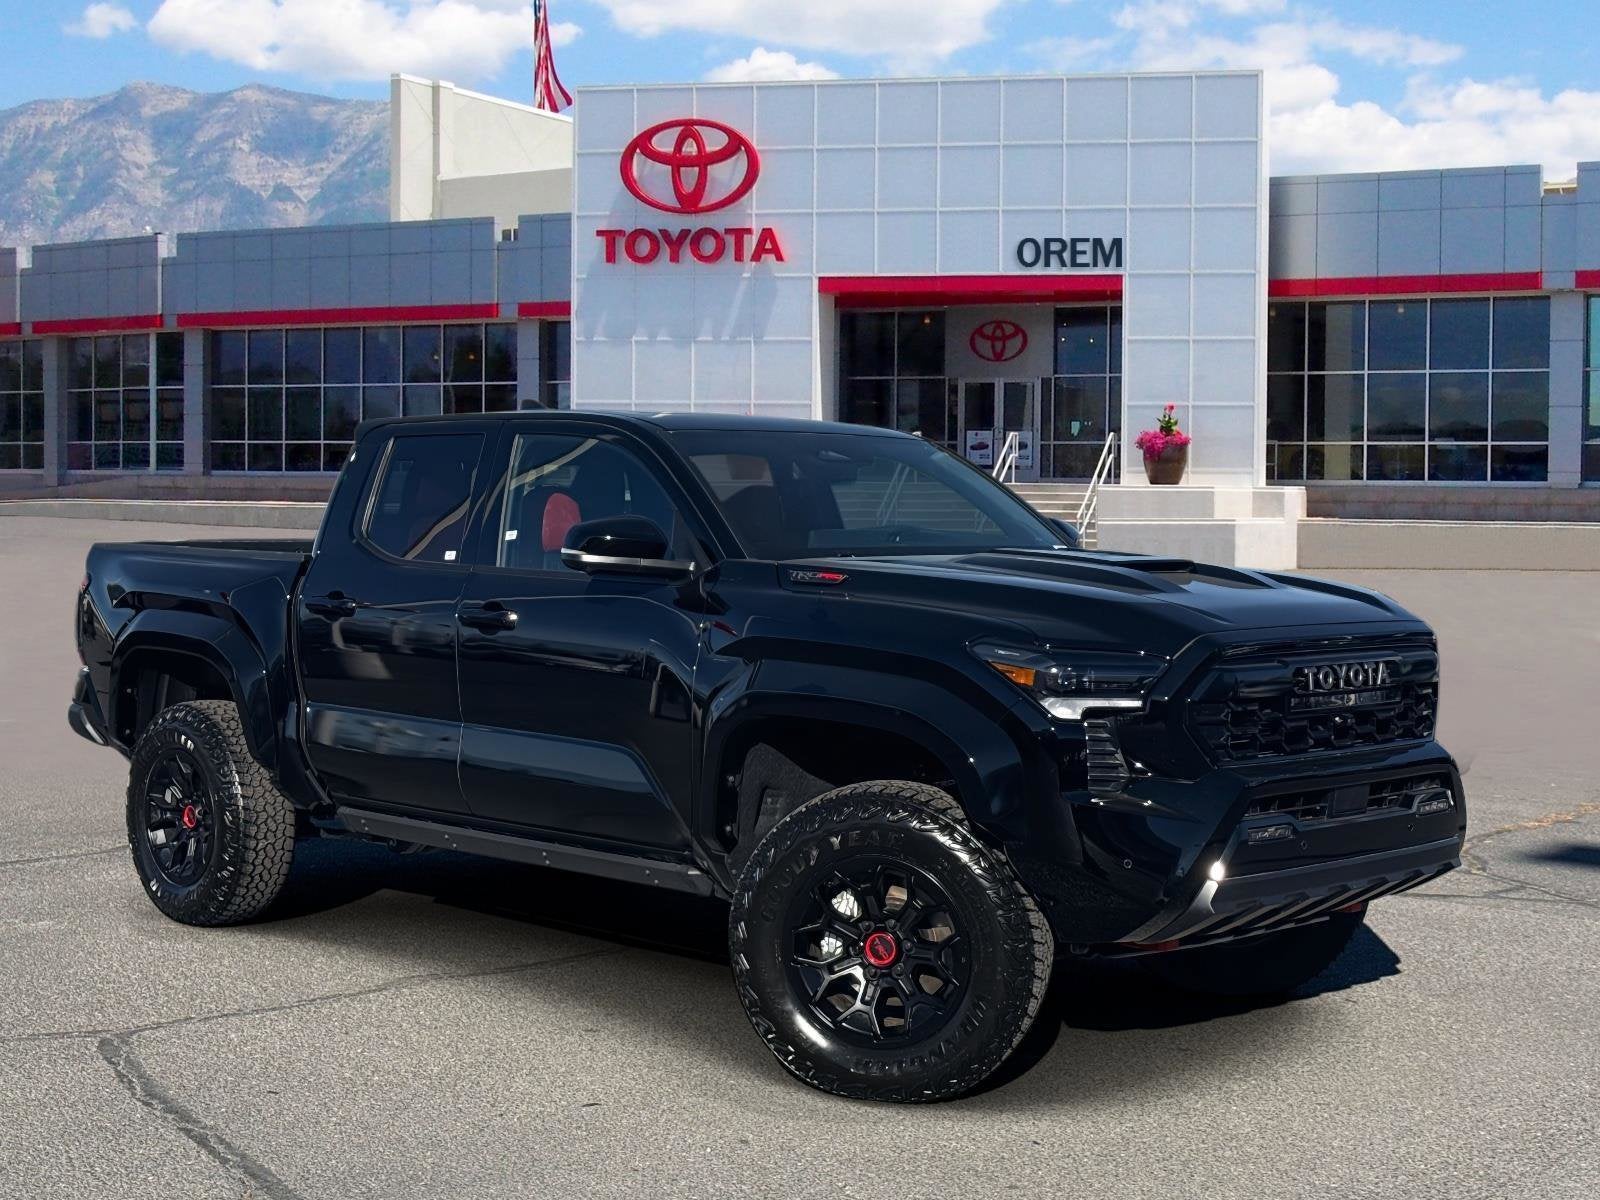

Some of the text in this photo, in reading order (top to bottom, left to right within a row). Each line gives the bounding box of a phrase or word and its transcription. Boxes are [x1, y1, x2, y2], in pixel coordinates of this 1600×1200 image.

[596, 227, 785, 264] TOYOTA
[1017, 237, 1123, 268] OREM
[1304, 662, 1391, 691] TOYOTA
